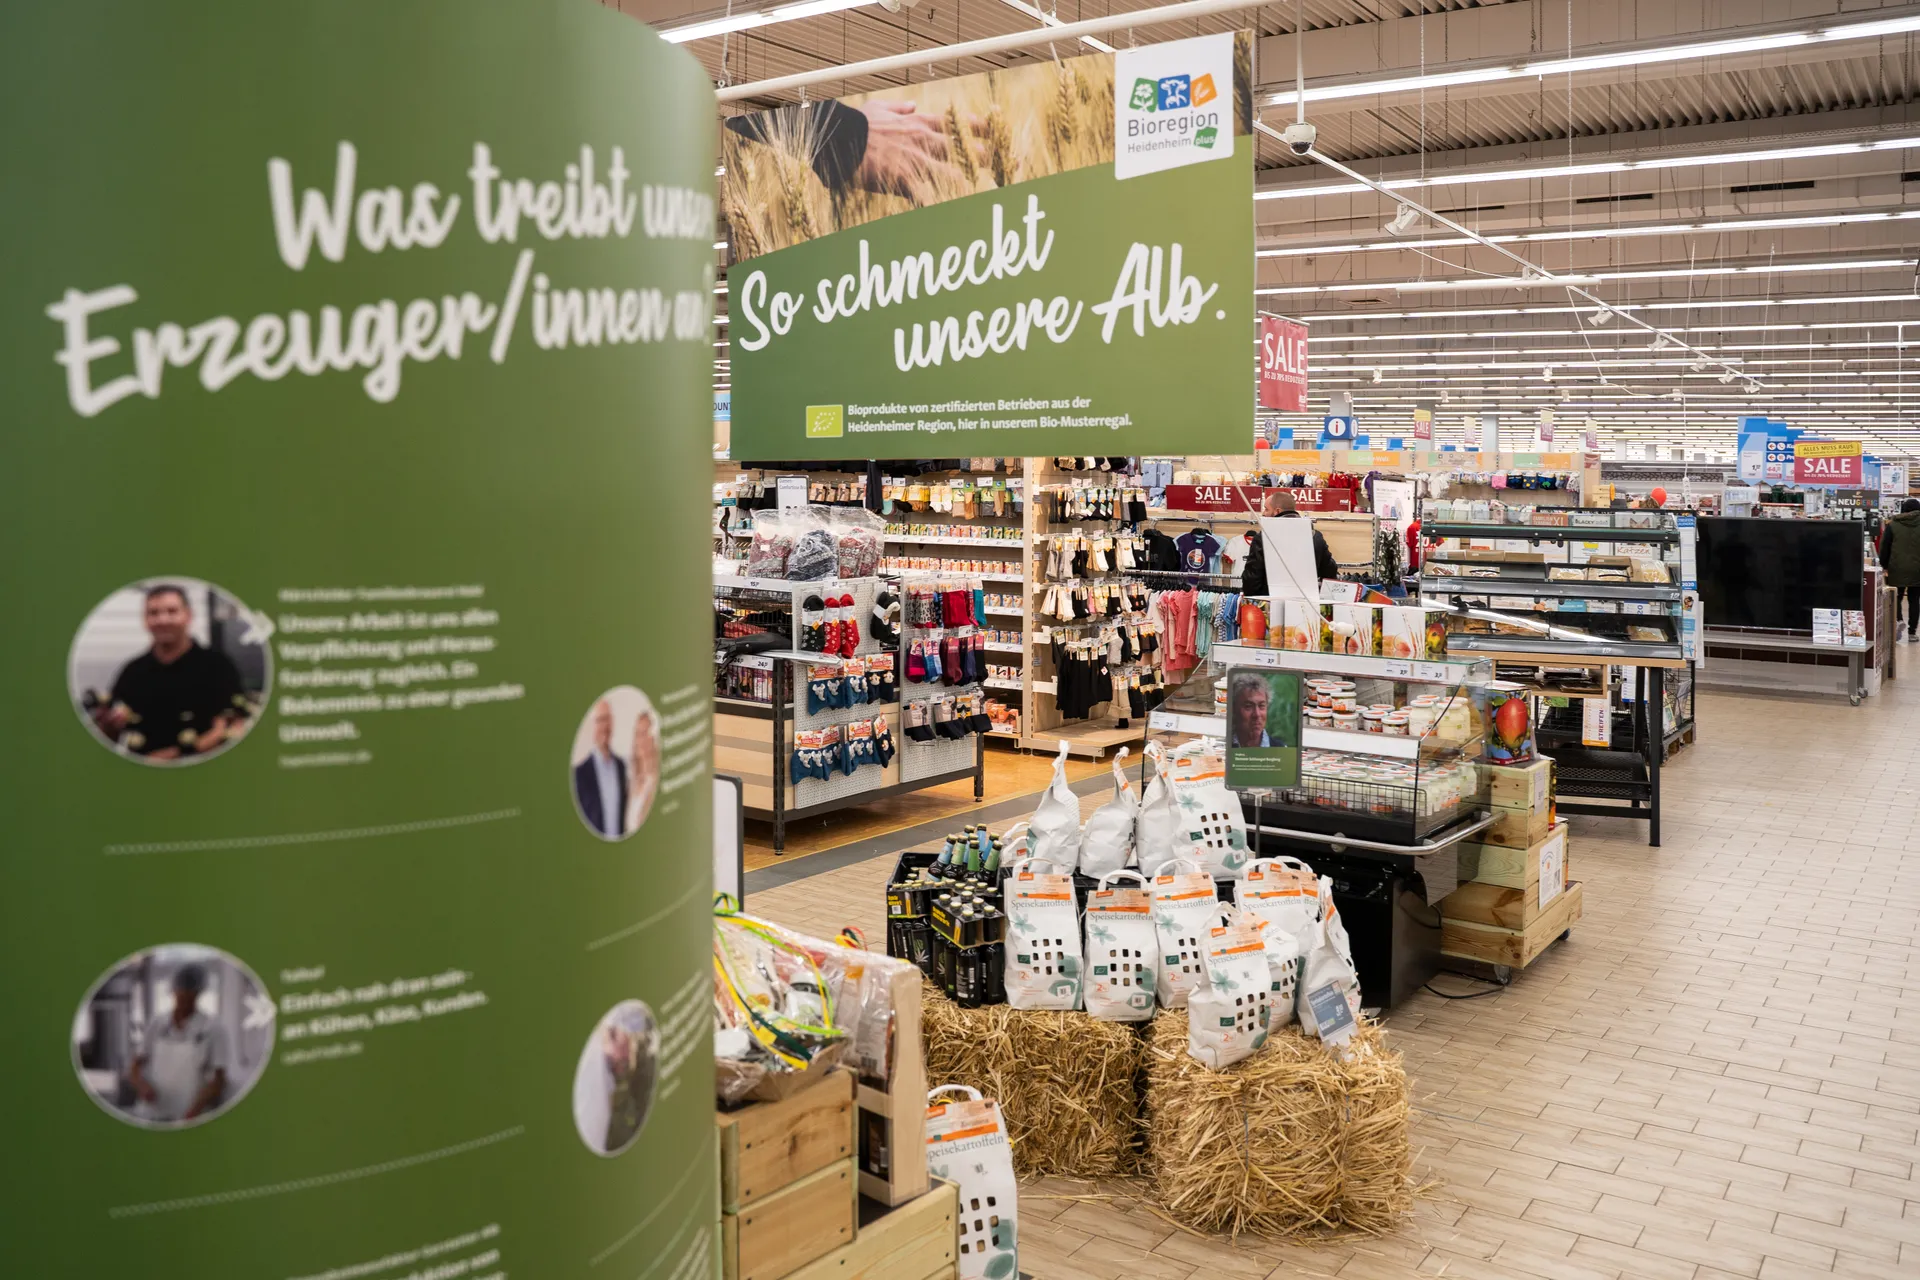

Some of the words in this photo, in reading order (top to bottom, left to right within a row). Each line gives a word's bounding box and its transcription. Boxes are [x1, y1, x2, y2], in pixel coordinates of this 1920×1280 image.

[1127, 110, 1219, 137] Bioregion
[1127, 137, 1192, 153] Heidenheim
[1195, 135, 1216, 146] plus
[266, 139, 461, 271] Was
[468, 140, 637, 243] treibt
[738, 268, 804, 353] So
[812, 193, 1055, 324] schmeckt
[893, 295, 1084, 372] unsere
[1090, 242, 1227, 344] Alb.
[45, 248, 673, 418] Erzeuger/innen
[1264, 332, 1305, 376] SALE
[847, 403, 907, 417] Bioprodukte
[909, 403, 929, 413] von
[930, 400, 995, 413] zertifizierten
[997, 399, 1049, 411] Betrieben
[1051, 399, 1069, 409] aus
[1072, 396, 1091, 409] der
[847, 420, 914, 433] Heidenheimer
[916, 420, 956, 434] Region,
[958, 418, 977, 430] hier
[980, 418, 990, 430] in
[992, 419, 1038, 430] unserem
[1039, 414, 1132, 429] Bio-Musterregal.
[1416, 421, 1429, 434] SALE
[1804, 458, 1851, 474] SALE
[1195, 486, 1231, 500] SALE
[1290, 489, 1323, 502] SALE
[1837, 498, 1878, 507] NEUGIERIG
[1617, 545, 1650, 555] Katzen
[1011, 899, 1073, 911] Speisekartoffeln
[1089, 911, 1154, 922] Speisekartoffeln
[928, 1132, 1005, 1162] peisekartoffeln
